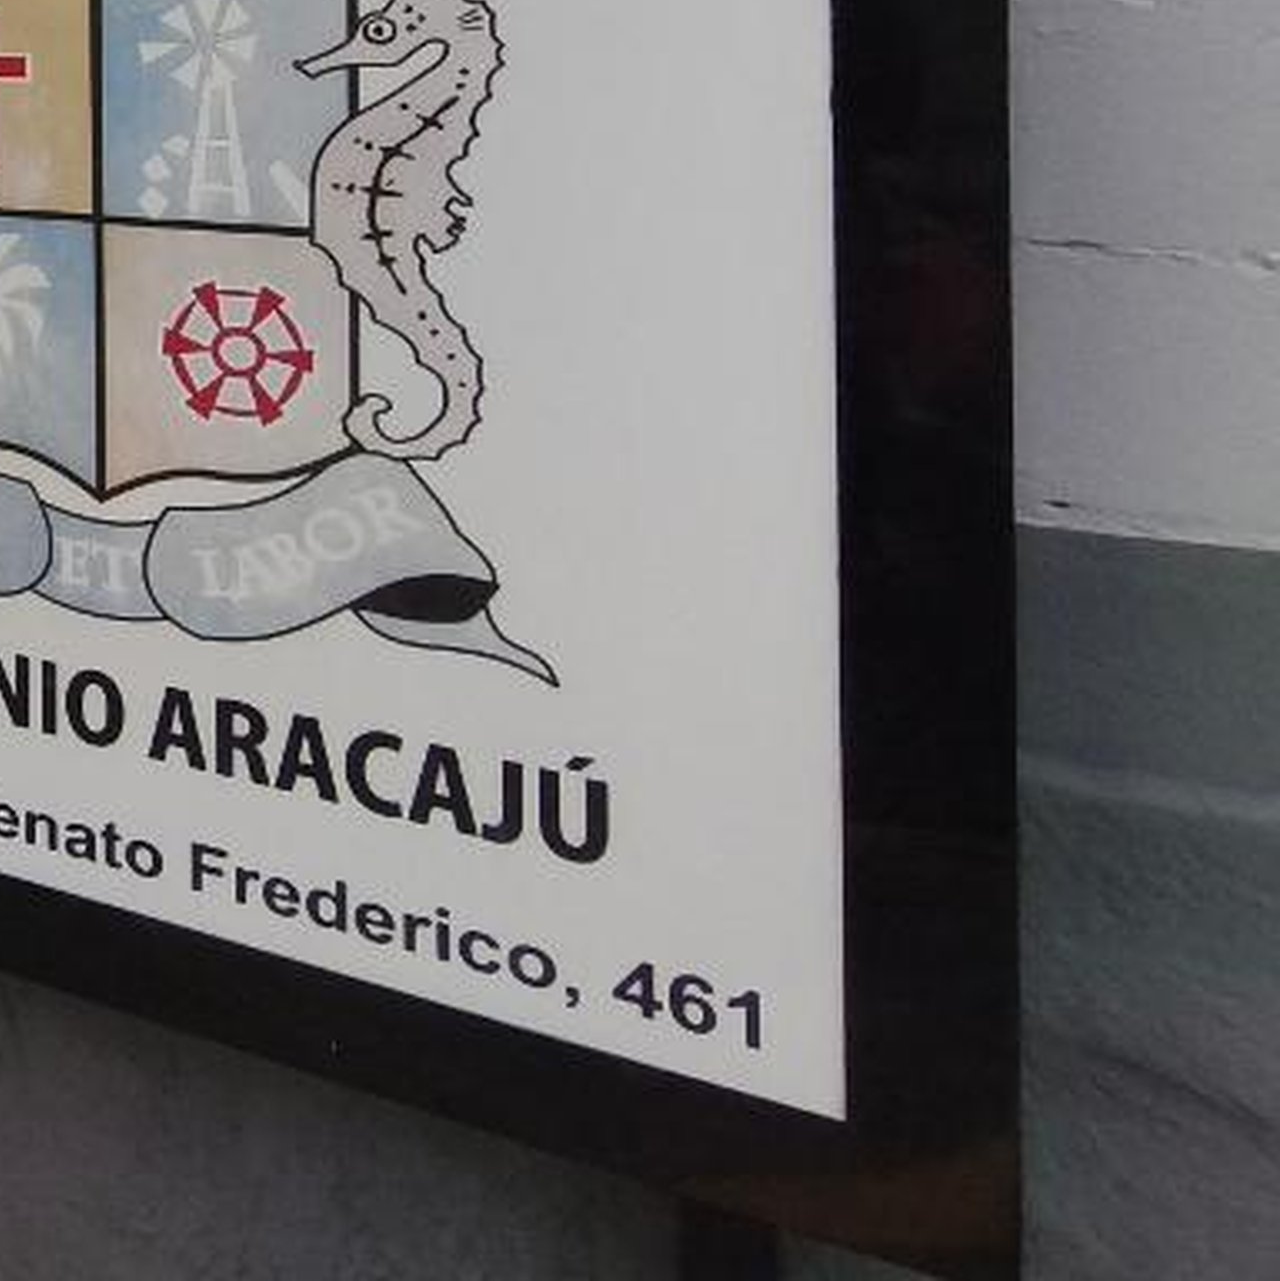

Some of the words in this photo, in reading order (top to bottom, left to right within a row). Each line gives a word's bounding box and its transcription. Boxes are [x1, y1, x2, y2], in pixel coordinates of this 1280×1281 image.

[55, 535, 140, 588] ET
[190, 485, 425, 601] LABOR
[147, 686, 609, 865] ARACAJÚ
[191, 842, 580, 1008] Frederico,
[612, 962, 761, 1050] 461
